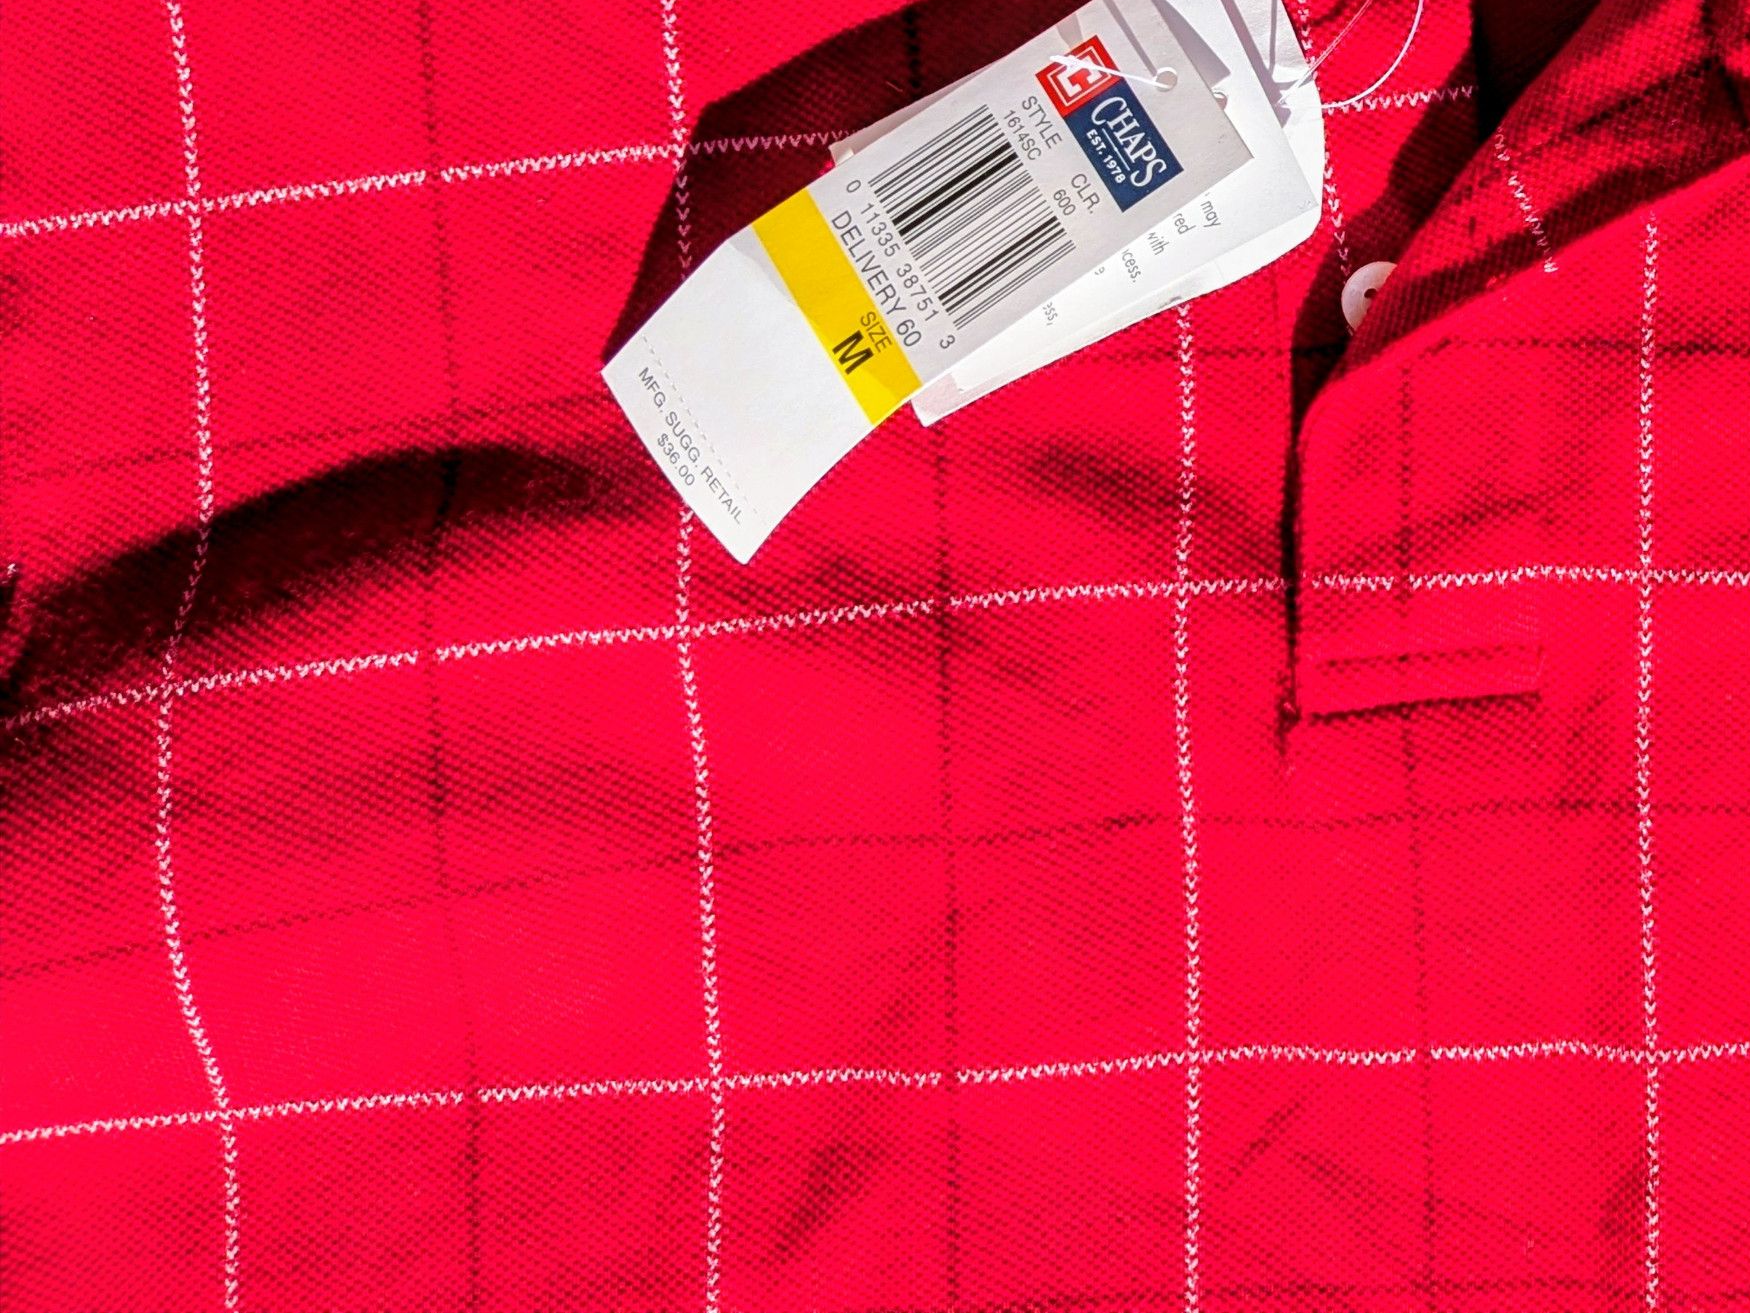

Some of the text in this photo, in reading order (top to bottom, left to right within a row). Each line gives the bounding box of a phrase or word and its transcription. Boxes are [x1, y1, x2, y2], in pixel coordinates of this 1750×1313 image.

[1004, 110, 1076, 216] 1614SC 600
[1022, 95, 1101, 214] STYLE CLR.
[1086, 128, 1127, 184] EST. 1978
[1091, 96, 1167, 187] CHAPS
[1200, 200, 1222, 228] may
[831, 210, 922, 348] DELIVERY 60
[846, 179, 956, 349] 0 11335 38751 3
[832, 329, 874, 375] M
[860, 311, 892, 353] SIZE
[638, 367, 744, 525] MFG. SUGG. RETAIL
[657, 433, 695, 486] $36.00
